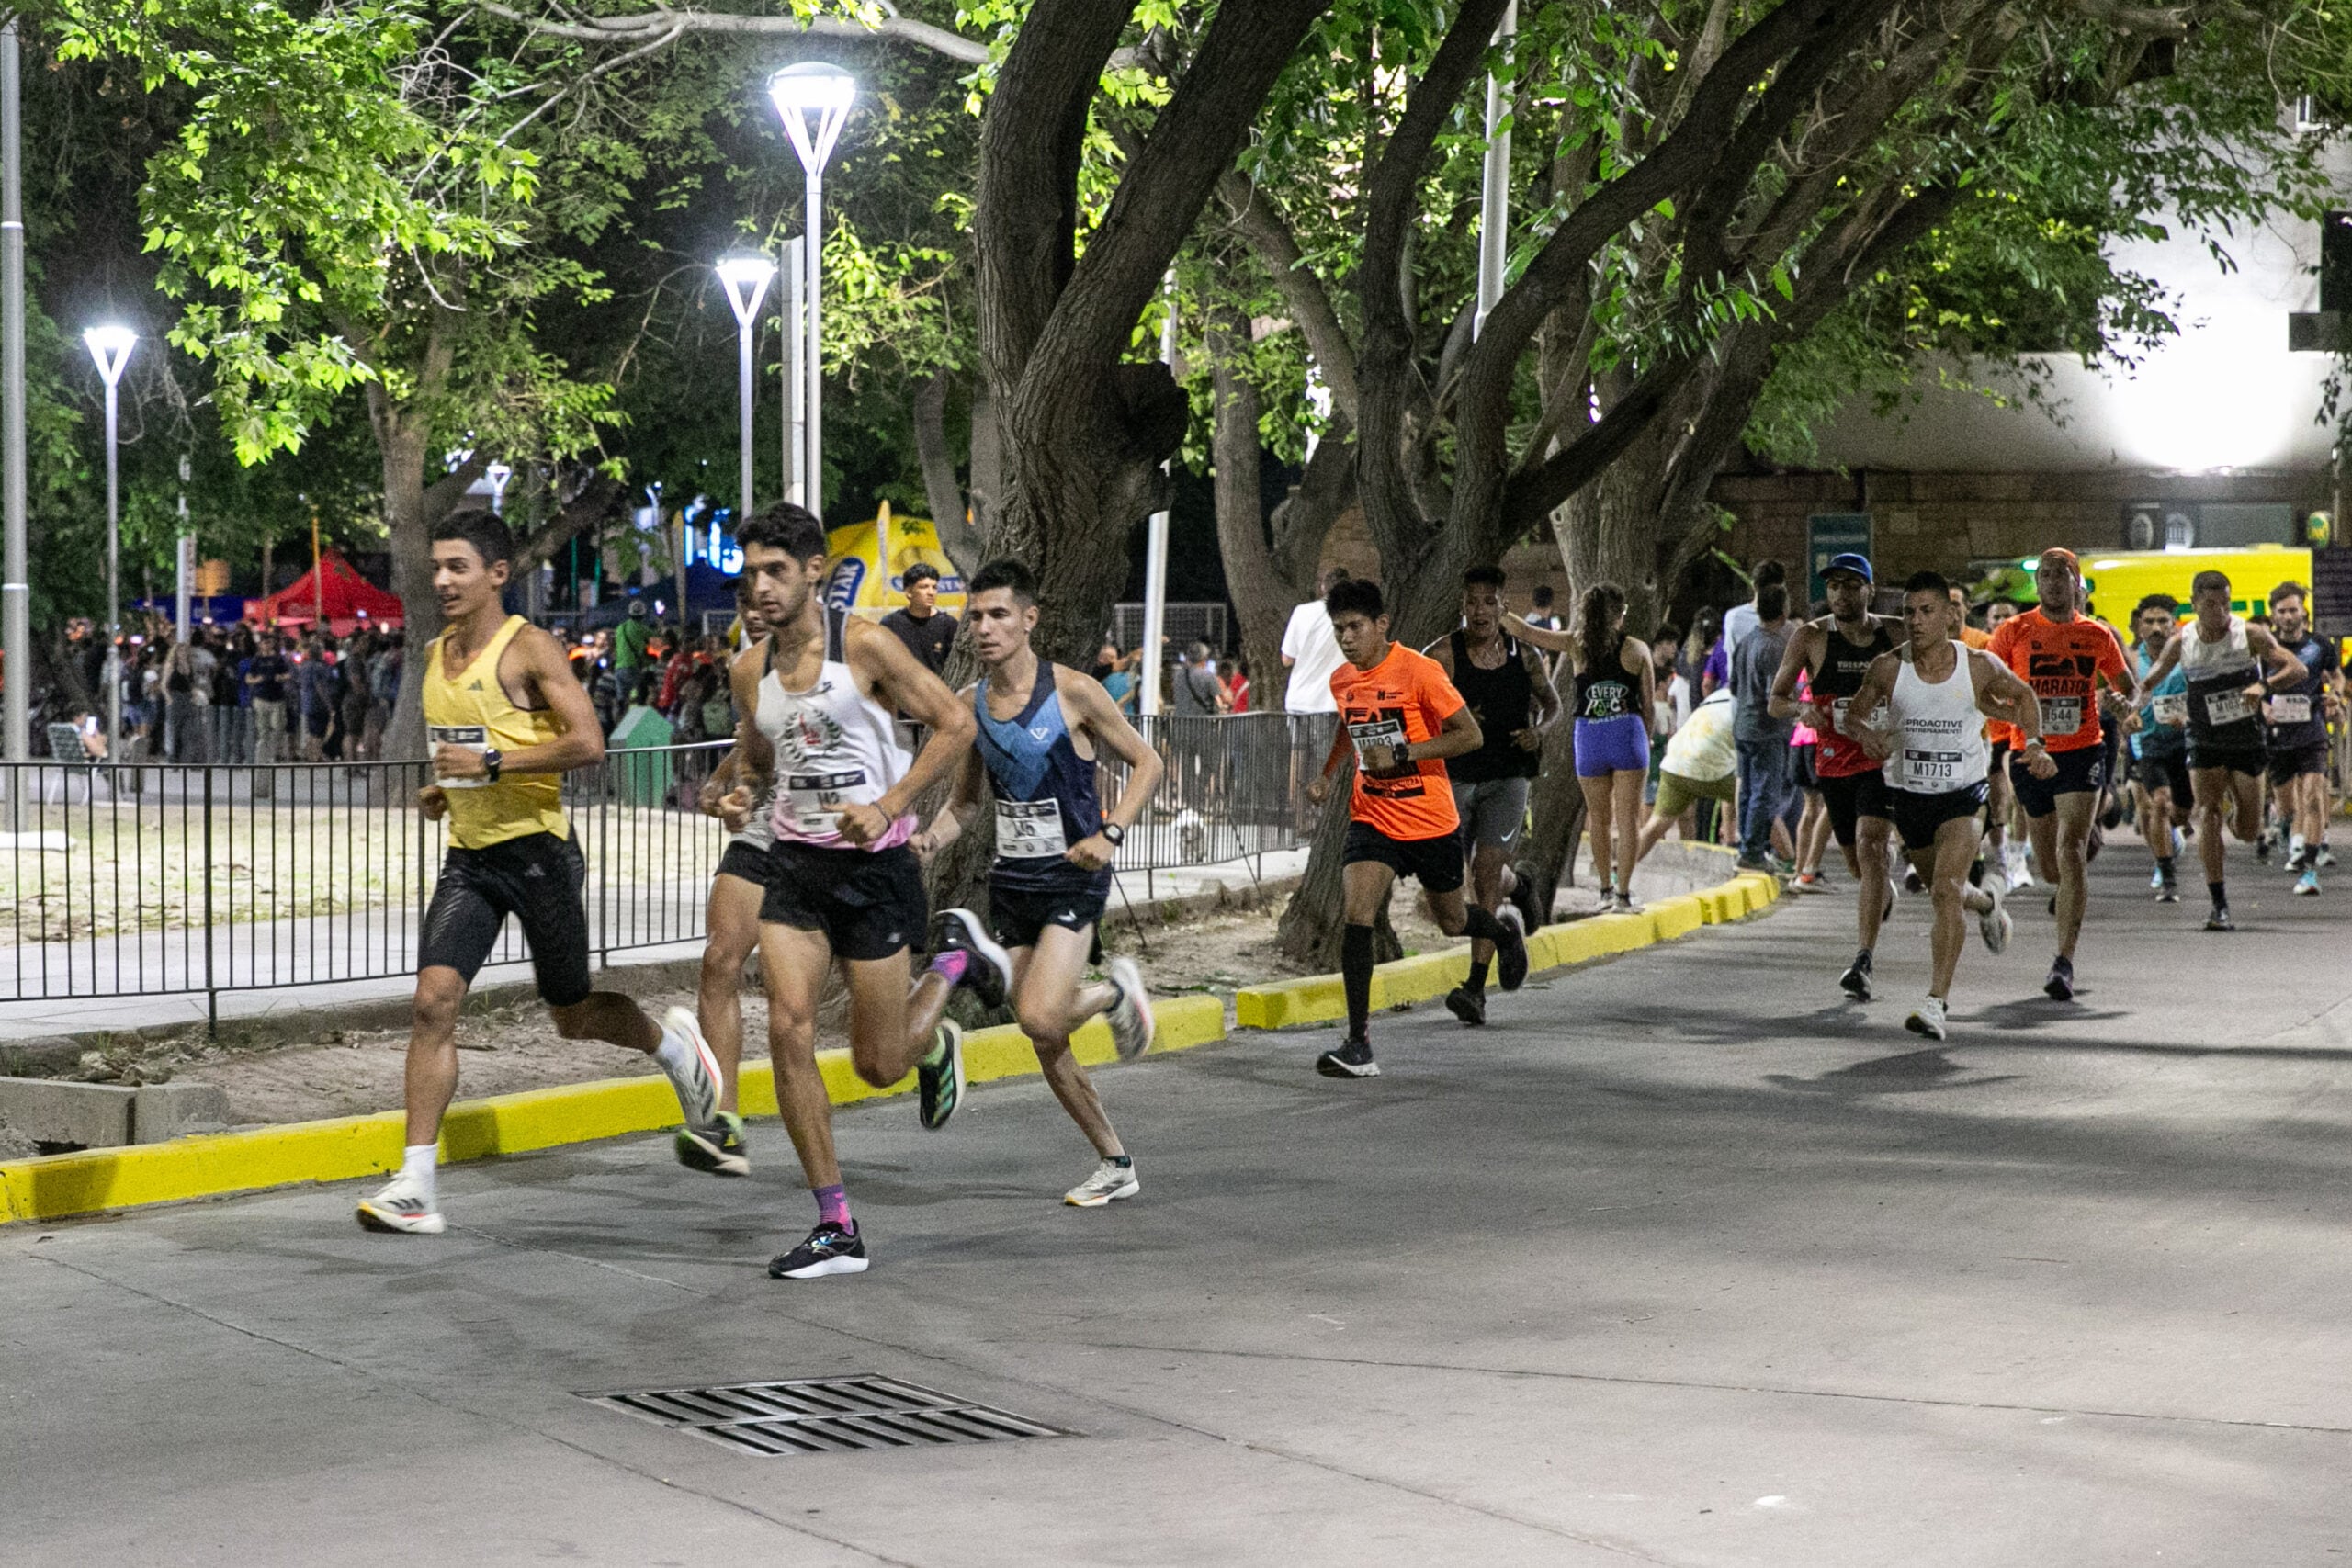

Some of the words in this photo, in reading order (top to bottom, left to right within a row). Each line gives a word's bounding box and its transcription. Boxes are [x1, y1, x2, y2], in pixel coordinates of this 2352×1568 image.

[1591, 685, 1623, 699] EVERY
[1905, 719, 1962, 728] PROACTIVE
[1913, 761, 1952, 778] M1713
